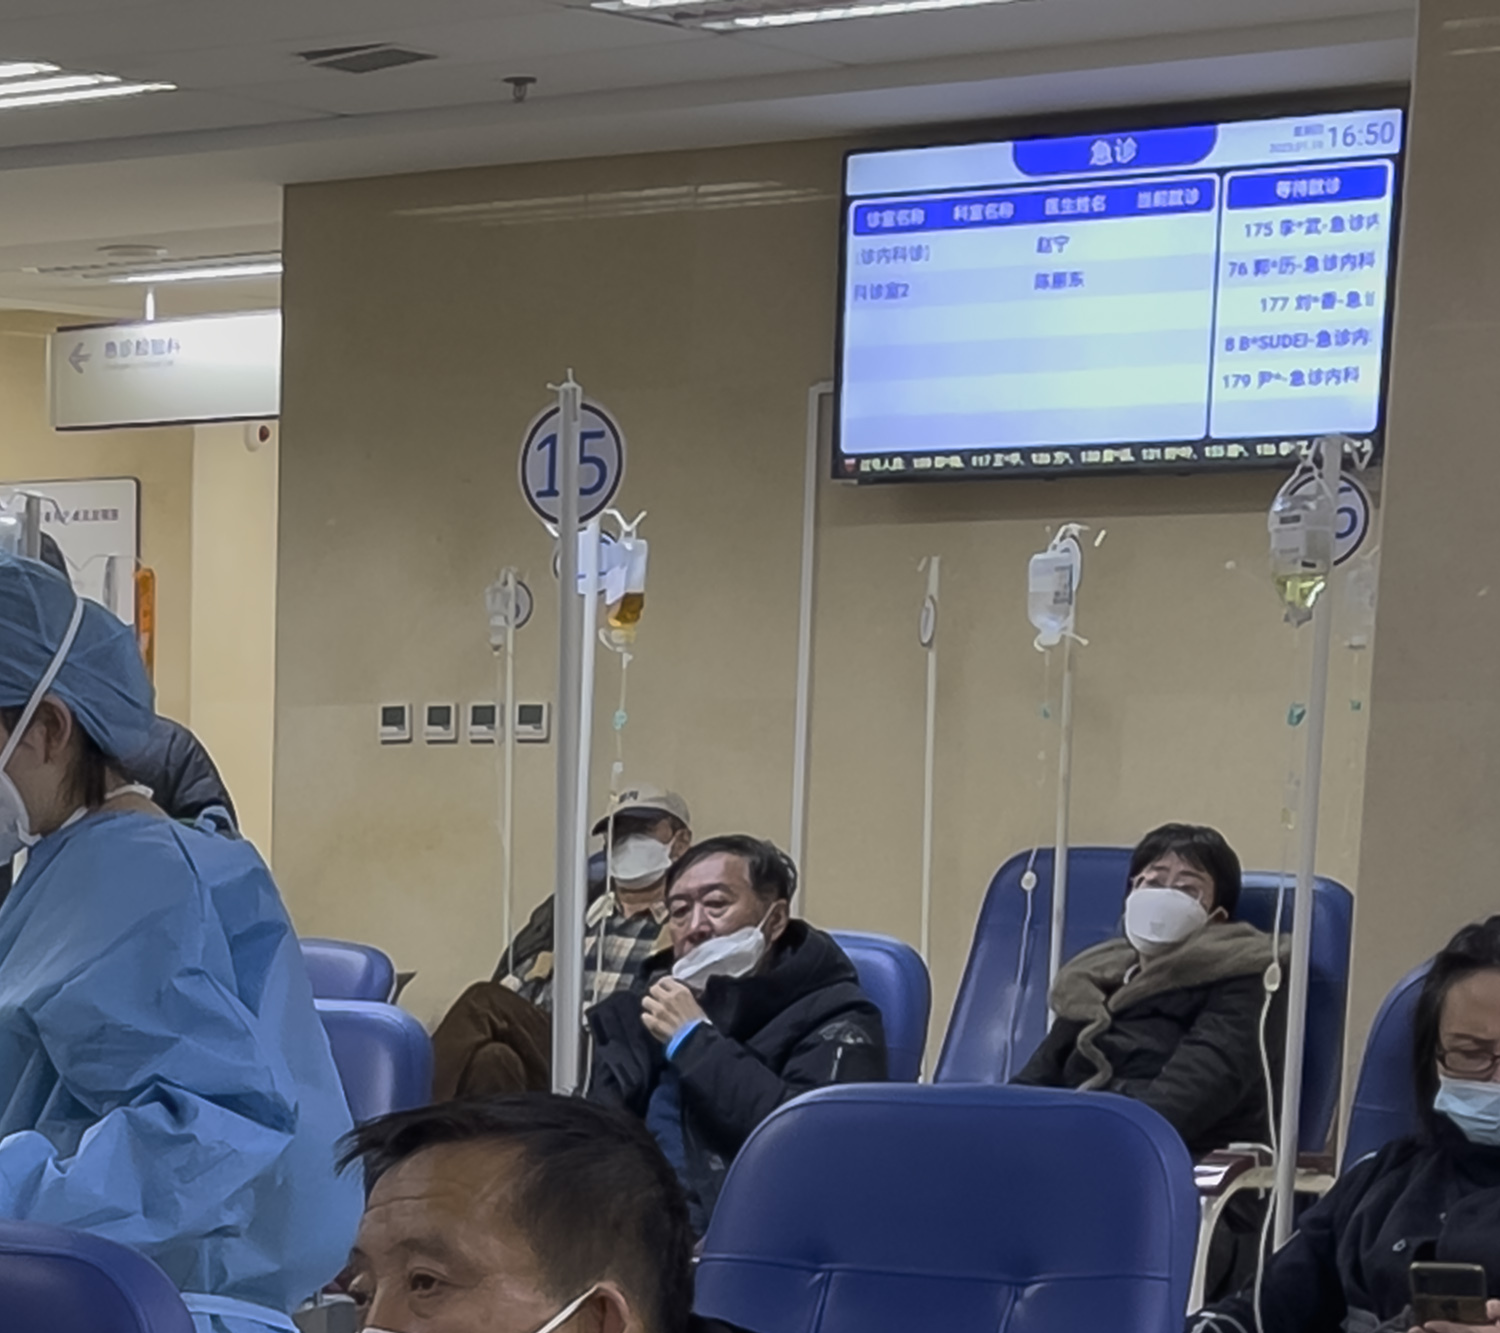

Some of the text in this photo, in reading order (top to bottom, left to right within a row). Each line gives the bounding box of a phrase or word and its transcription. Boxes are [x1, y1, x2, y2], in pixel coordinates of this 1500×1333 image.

[1328, 121, 1395, 148] 16:50
[1089, 137, 1137, 166] 急诊
[1044, 195, 1107, 216] 医生姓名
[1245, 221, 1273, 237] 175
[1261, 297, 1289, 312] 177
[1223, 374, 1251, 389] 179
[535, 430, 608, 497] 15
